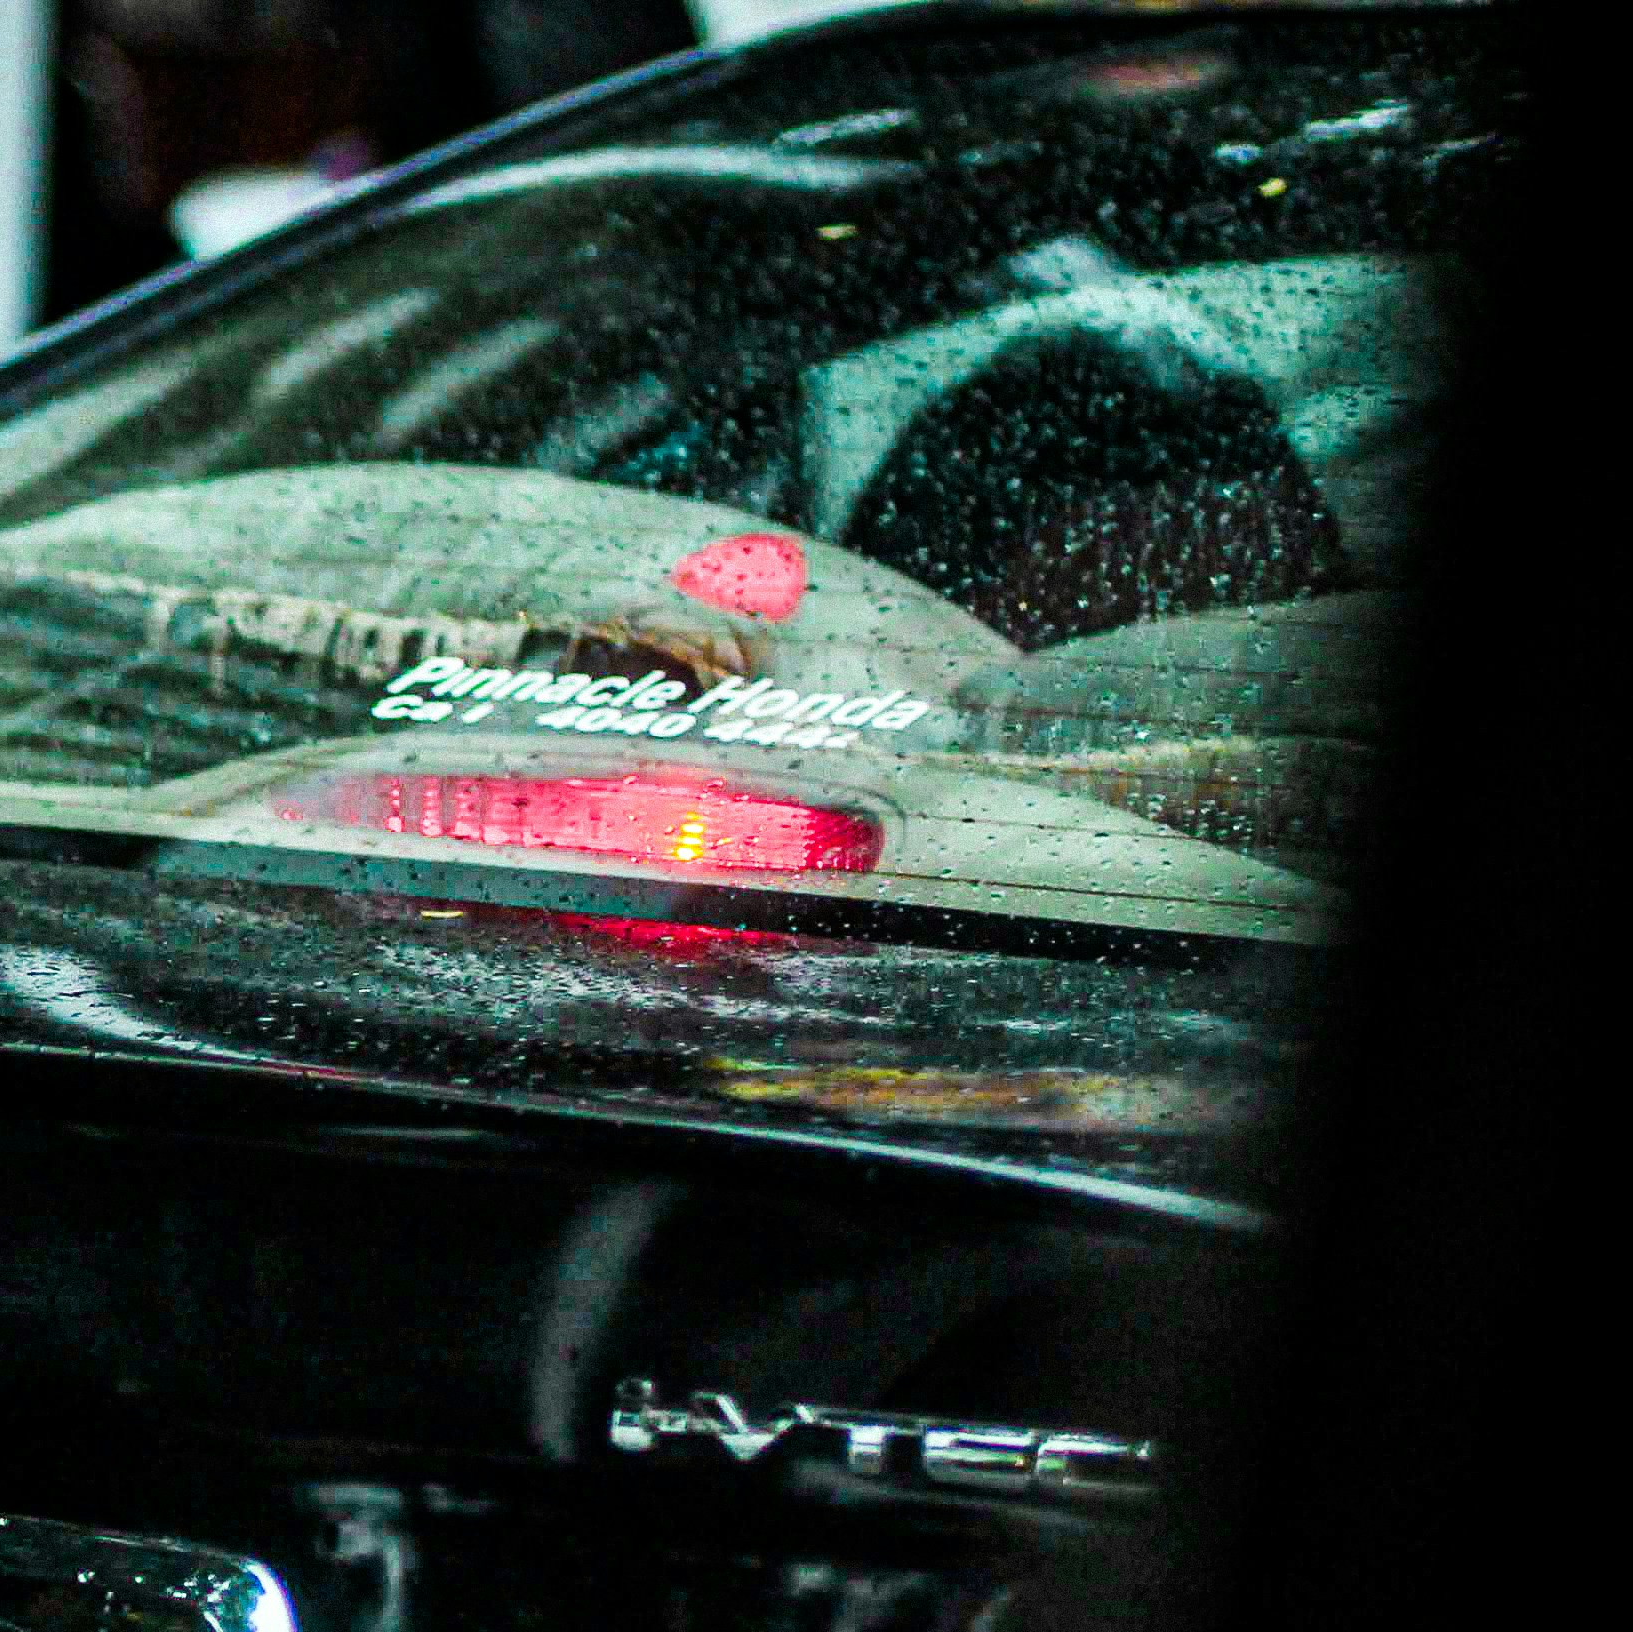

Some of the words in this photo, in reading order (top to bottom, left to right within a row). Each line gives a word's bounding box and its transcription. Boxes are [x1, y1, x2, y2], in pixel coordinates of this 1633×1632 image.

[386, 656, 686, 710] Pinnacle
[687, 675, 929, 730] Honda
[535, 706, 697, 737] 4040
